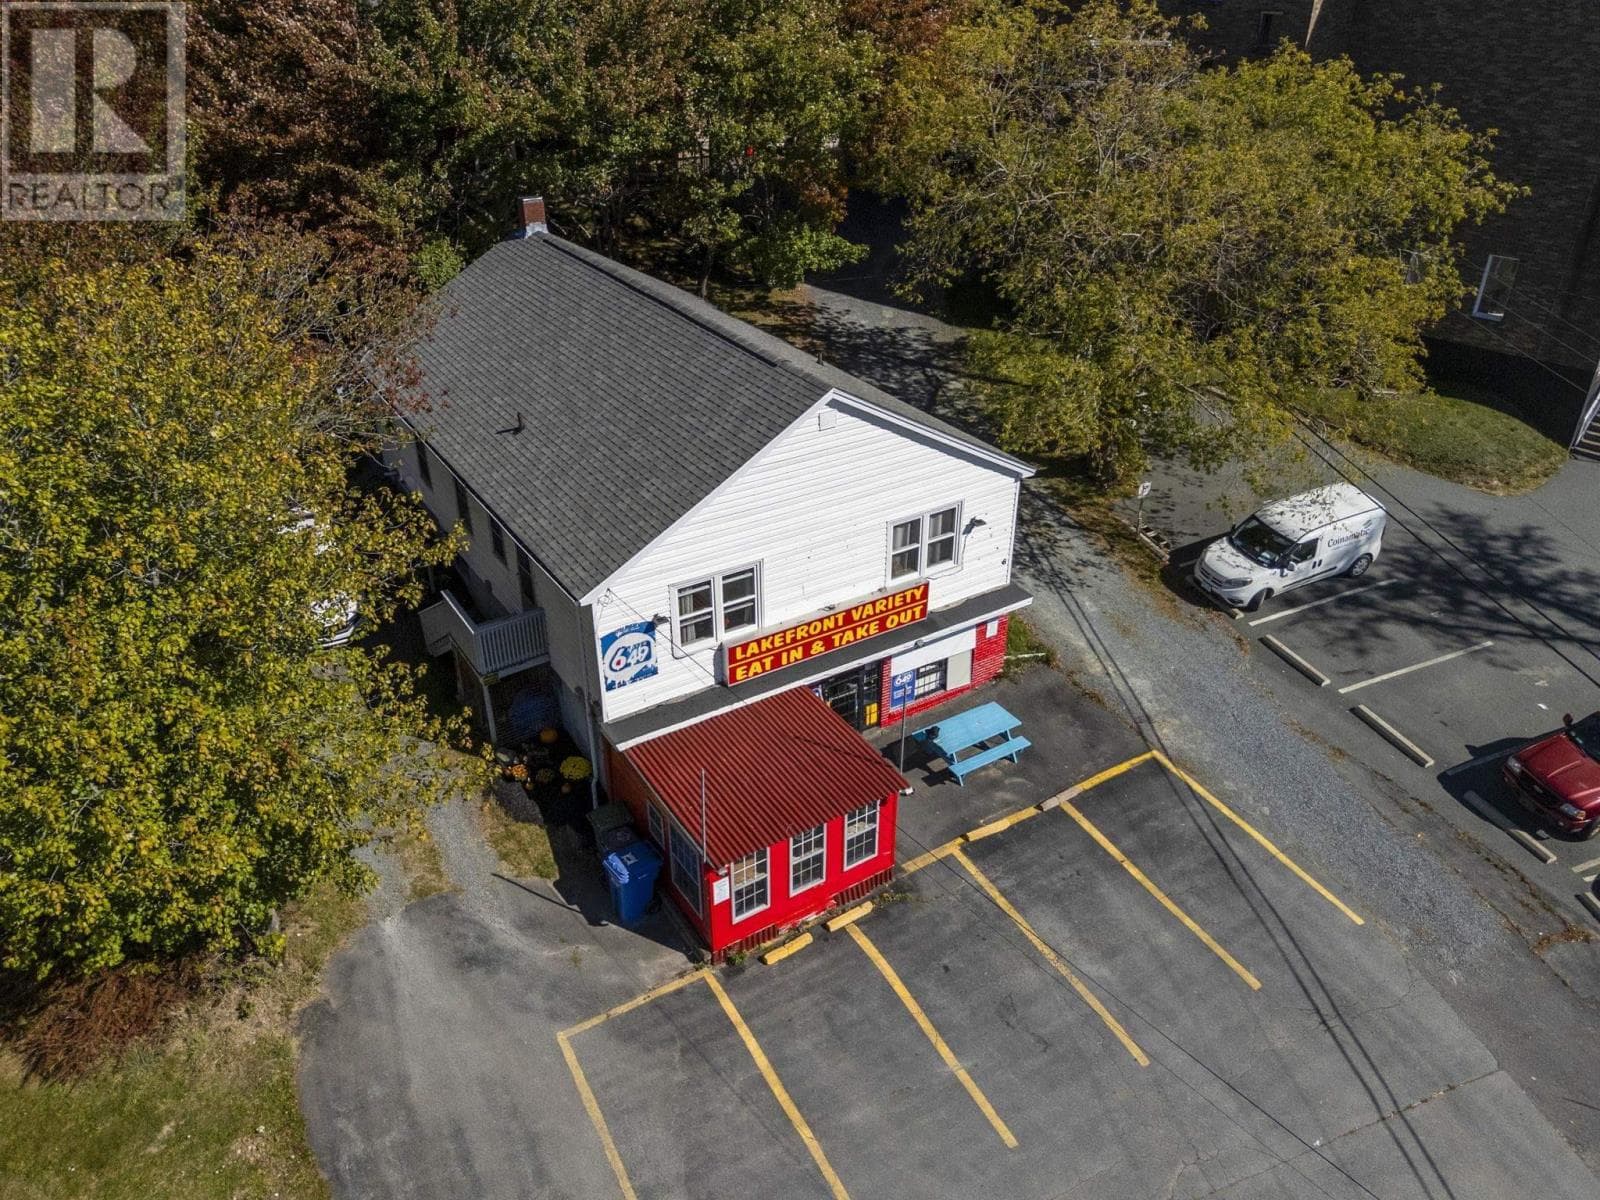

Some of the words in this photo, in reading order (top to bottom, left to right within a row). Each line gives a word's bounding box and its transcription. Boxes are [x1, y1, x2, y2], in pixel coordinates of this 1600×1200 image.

[735, 612, 847, 660] LAKEFRONT
[851, 585, 925, 620] VARIETY
[735, 656, 774, 681] EAT
[781, 647, 803, 665] IN
[810, 639, 825, 655] &
[832, 621, 879, 647] TAKE
[886, 605, 924, 628] OUT
